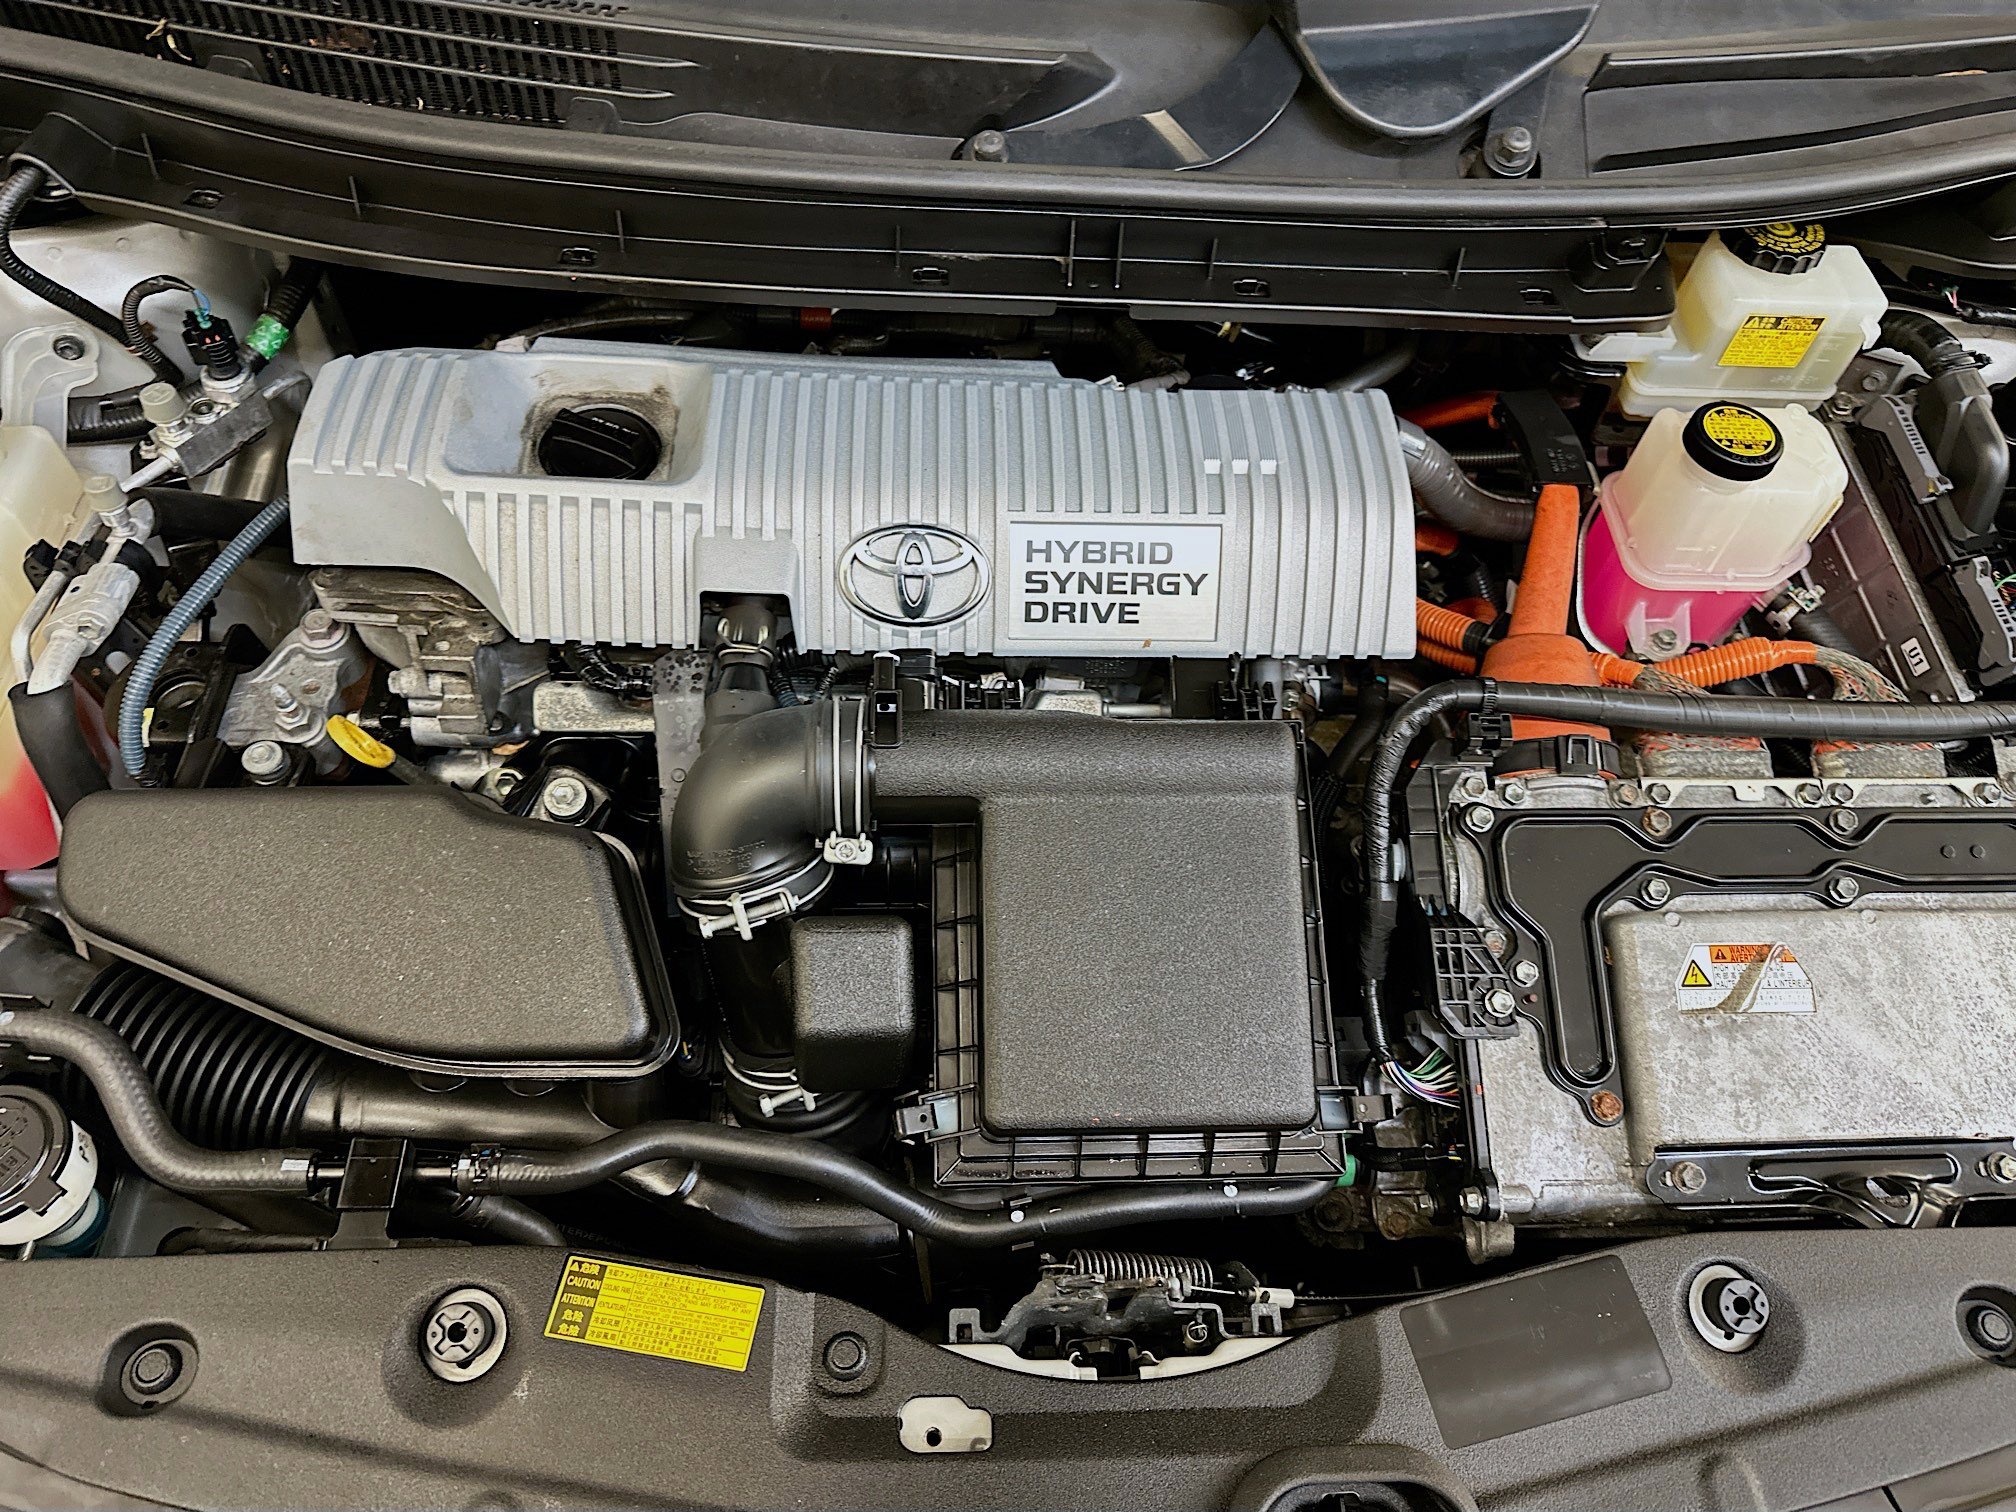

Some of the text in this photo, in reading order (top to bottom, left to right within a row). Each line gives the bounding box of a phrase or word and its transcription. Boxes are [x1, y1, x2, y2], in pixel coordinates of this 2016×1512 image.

[1026, 540, 1173, 565] HYBRID
[1025, 571, 1208, 595] SYNERGY
[1024, 601, 1140, 624] DRIVE
[1908, 646, 1924, 667] U1
[567, 1275, 601, 1290] CAUTION
[561, 1293, 596, 1308] ATTENTION
